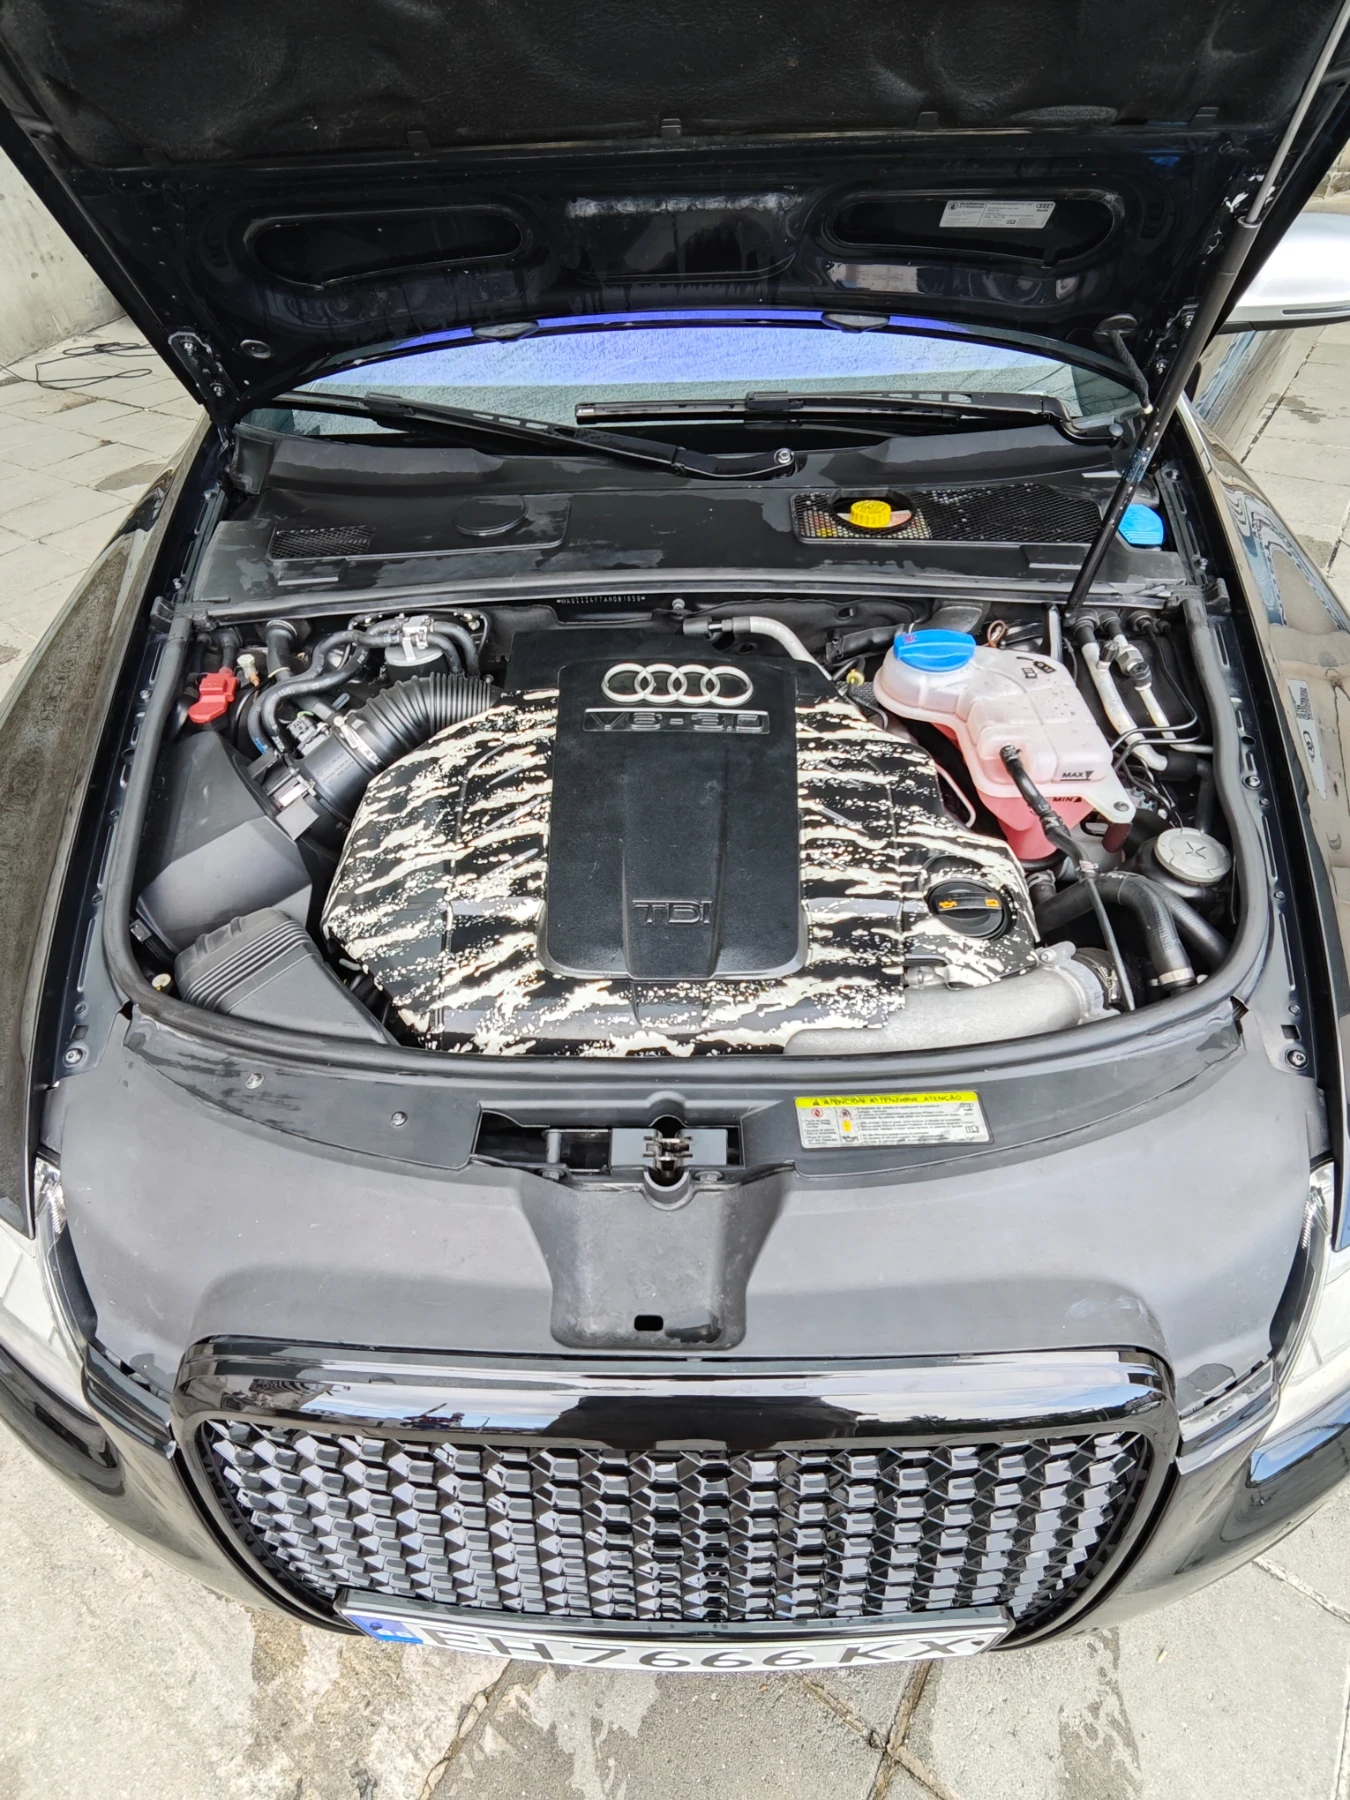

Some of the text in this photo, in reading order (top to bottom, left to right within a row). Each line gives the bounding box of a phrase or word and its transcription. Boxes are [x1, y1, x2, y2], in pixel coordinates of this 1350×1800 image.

[632, 899, 713, 924] TDI
[420, 1627, 973, 1668] EH 7666 KX
